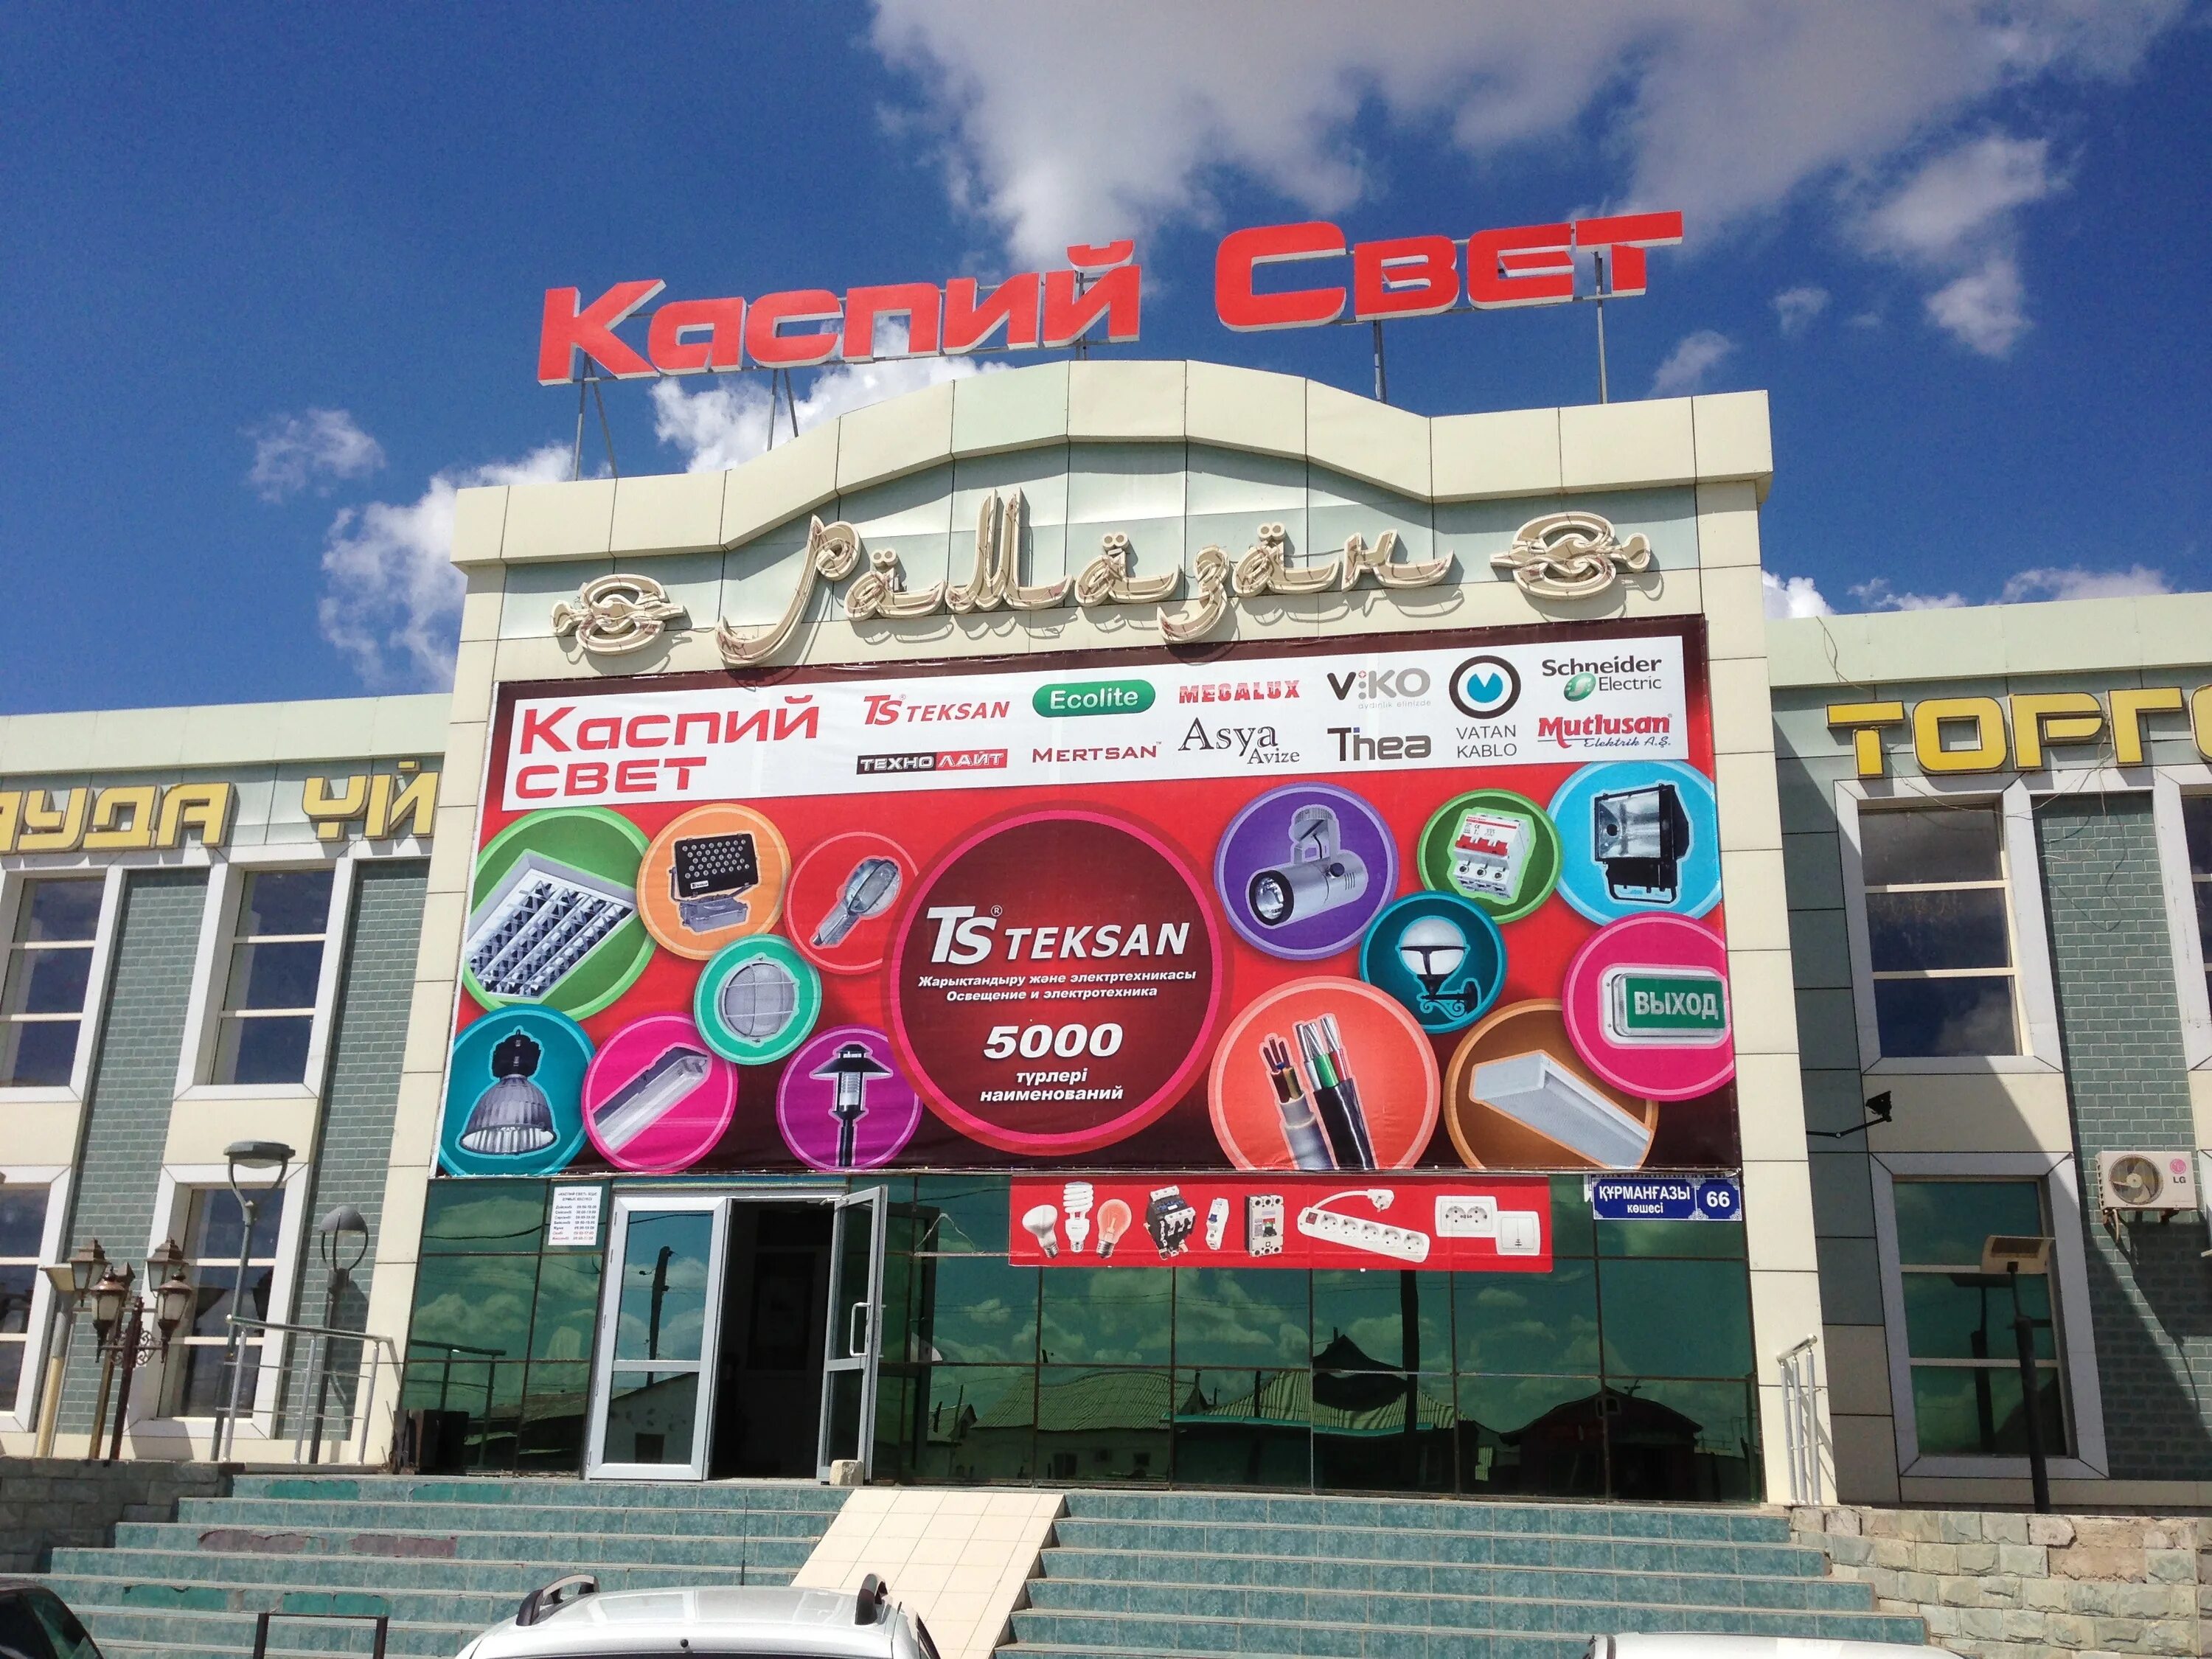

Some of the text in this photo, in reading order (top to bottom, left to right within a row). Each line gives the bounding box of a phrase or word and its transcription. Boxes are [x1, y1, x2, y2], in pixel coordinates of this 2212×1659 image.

[538, 239, 1141, 386] Каспий
[1542, 655, 1662, 676] Schneider
[1179, 680, 1300, 703] MEGALUX
[1599, 676, 1662, 692] Electric
[1050, 687, 1138, 710] Ecolite
[907, 701, 1010, 723] TEKSAN
[519, 695, 819, 755] Каспий
[1455, 724, 1517, 740] VATAN
[1537, 714, 1671, 749] Mutlusan
[1178, 717, 1279, 757] Asya
[1326, 727, 1431, 762] Thea
[1032, 745, 1157, 763] MERTSAN
[1247, 748, 1300, 765] Avize
[1456, 743, 1517, 759] KABLO
[1004, 922, 1190, 960] TEKSAN
[1029, 975, 1066, 984] және
[946, 990, 1027, 1002] Освещение
[1043, 987, 1158, 1000] электротехника
[1633, 991, 1719, 1020] ВЫХОД
[983, 1022, 1124, 1059] 5000
[1016, 1068, 1088, 1087] түрлері
[979, 1085, 1124, 1102] наименований
[1599, 1186, 1691, 1202] ҚҰРМАНҒАЗЫ
[1706, 1191, 1731, 1208] 66
[1627, 1202, 1664, 1214] көшесі
